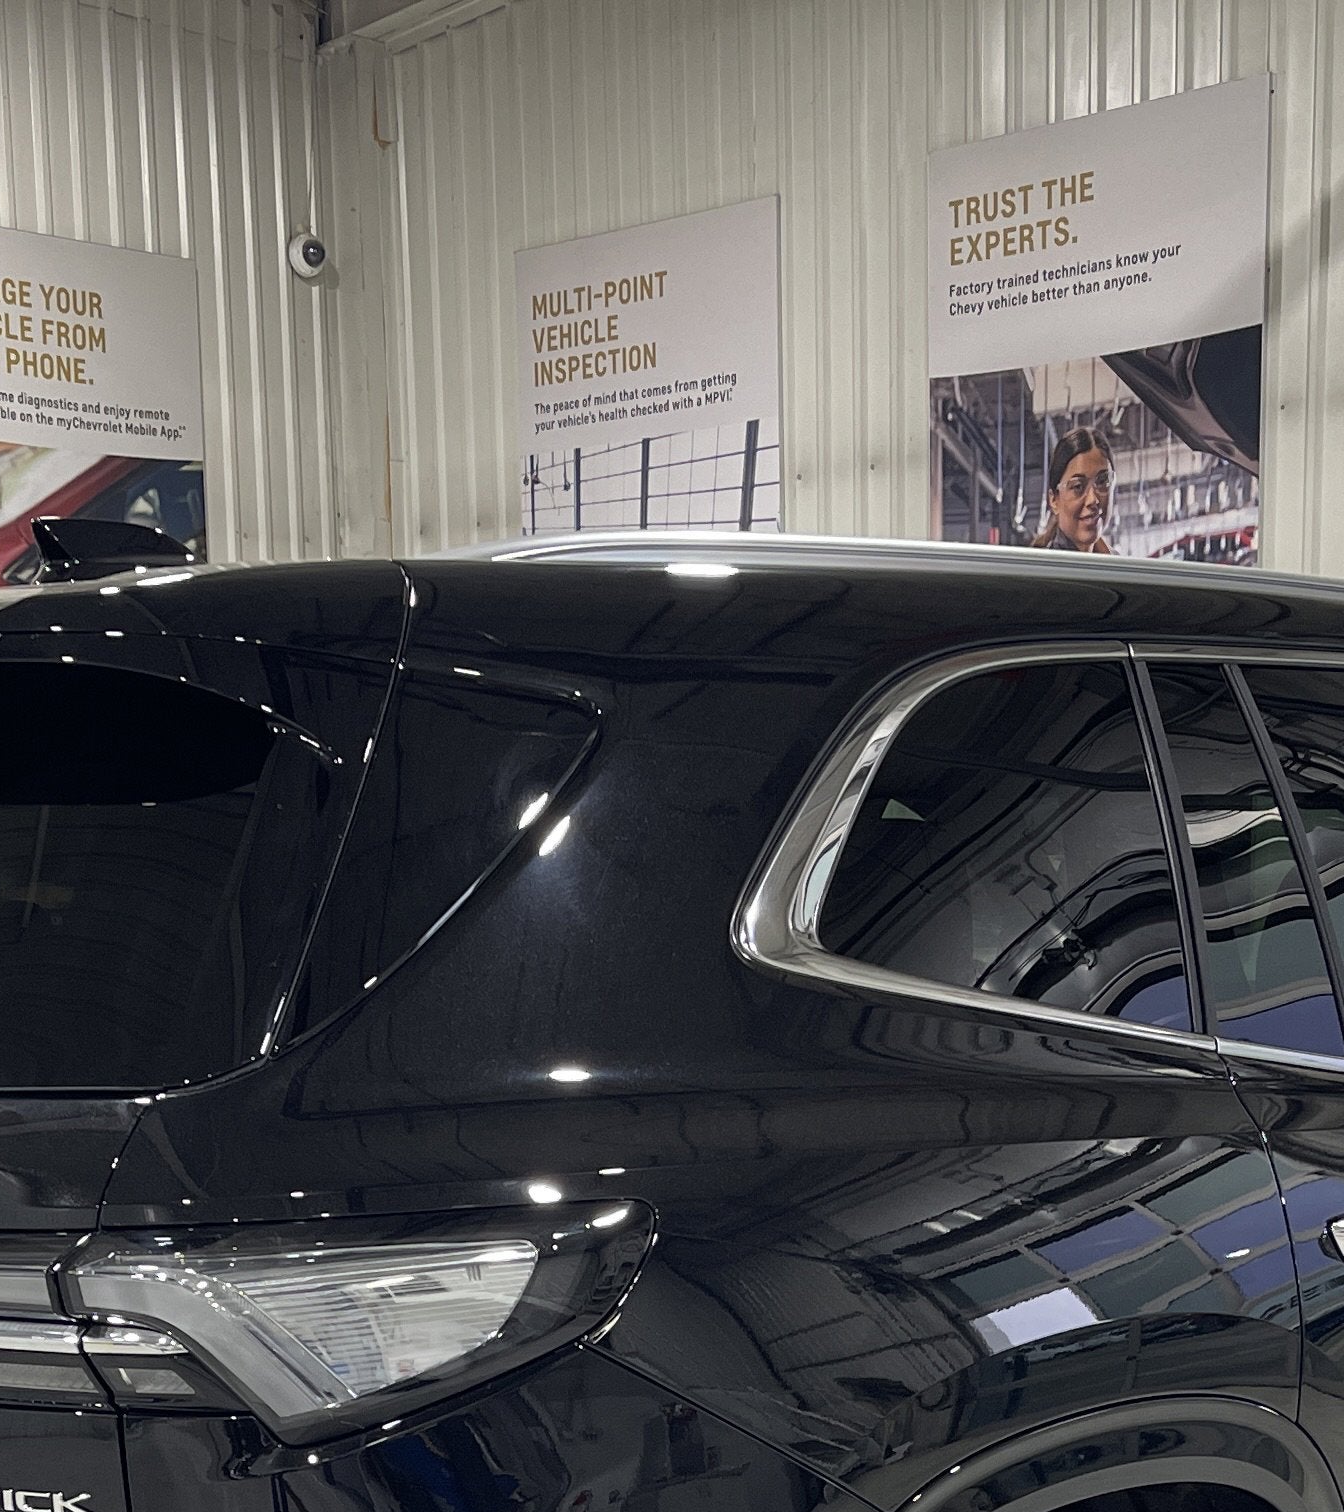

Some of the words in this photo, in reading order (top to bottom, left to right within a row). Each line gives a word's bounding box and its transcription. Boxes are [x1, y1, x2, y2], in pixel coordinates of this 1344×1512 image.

[949, 184, 1034, 228] TRUST
[1041, 171, 1094, 210] THE
[949, 216, 1078, 266] EXPERTS.
[949, 281, 993, 297] Factory
[997, 270, 1039, 290] trained
[1043, 259, 1112, 281] technicians
[1116, 251, 1149, 269] know
[1152, 244, 1181, 264] your
[39, 283, 103, 319] YOUR
[532, 270, 668, 320] MULTI-POINT
[949, 301, 984, 316] Chevy
[987, 291, 1028, 310] vehicle
[1032, 286, 1069, 303] better
[1073, 281, 1100, 296] than
[1104, 271, 1152, 291] anyone.
[42, 319, 106, 353] FROM
[532, 314, 619, 353] VEHICLE
[6, 347, 94, 385] PHONE.
[534, 341, 657, 388] INSPECTION
[17, 392, 78, 411] diagnostics
[82, 402, 100, 414] and
[103, 404, 131, 420] enjoy
[133, 408, 170, 421] remote
[534, 403, 551, 415] The
[553, 399, 579, 415] peace
[582, 394, 591, 407] of
[594, 390, 617, 406] mind
[619, 388, 638, 402] that
[641, 384, 672, 399] comes
[675, 379, 698, 393] from
[701, 372, 736, 392] getting
[19, 412, 33, 423] on
[35, 412, 54, 426] the
[57, 416, 122, 434] myChevrolet
[125, 422, 157, 437] Mobile
[535, 420, 555, 435] your
[599, 407, 628, 422] health
[630, 399, 670, 417] checked
[672, 395, 694, 410] with
[696, 397, 702, 407] a
